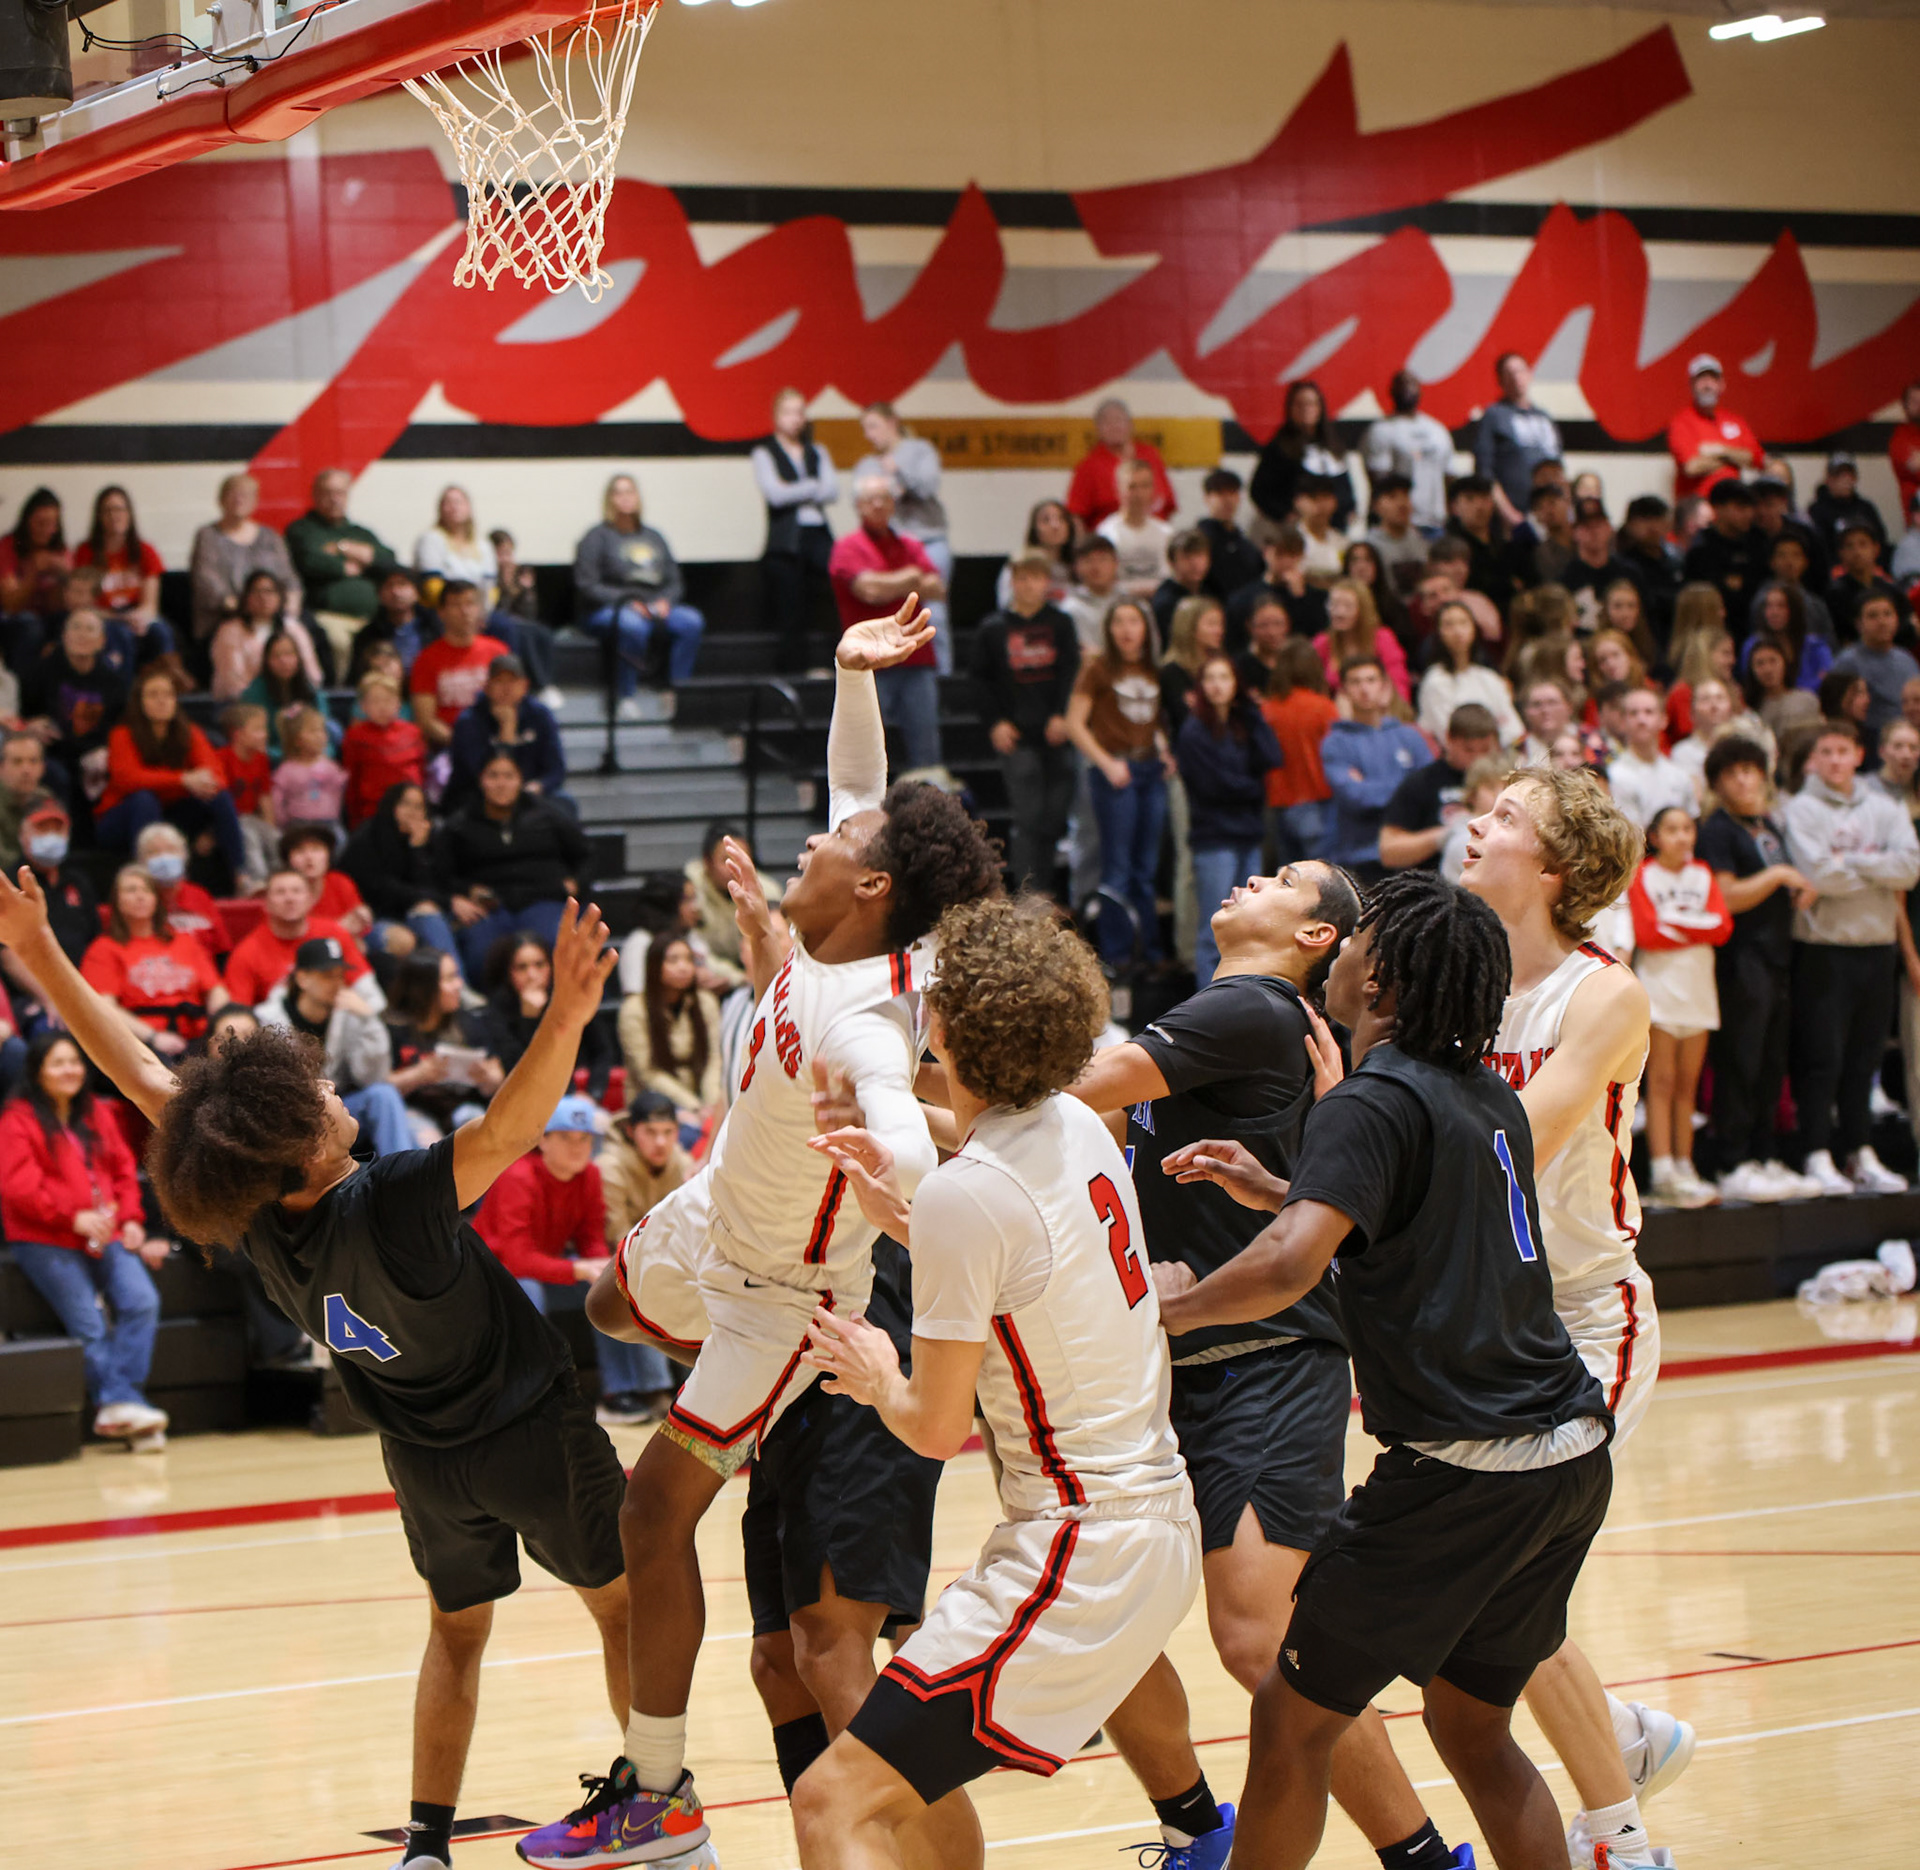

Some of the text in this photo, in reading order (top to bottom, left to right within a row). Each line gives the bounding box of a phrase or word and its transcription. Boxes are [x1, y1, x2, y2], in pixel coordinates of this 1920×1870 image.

[1087, 1171, 1149, 1311] 2
[1493, 1129, 1539, 1263] 1
[323, 1292, 402, 1363] 4
